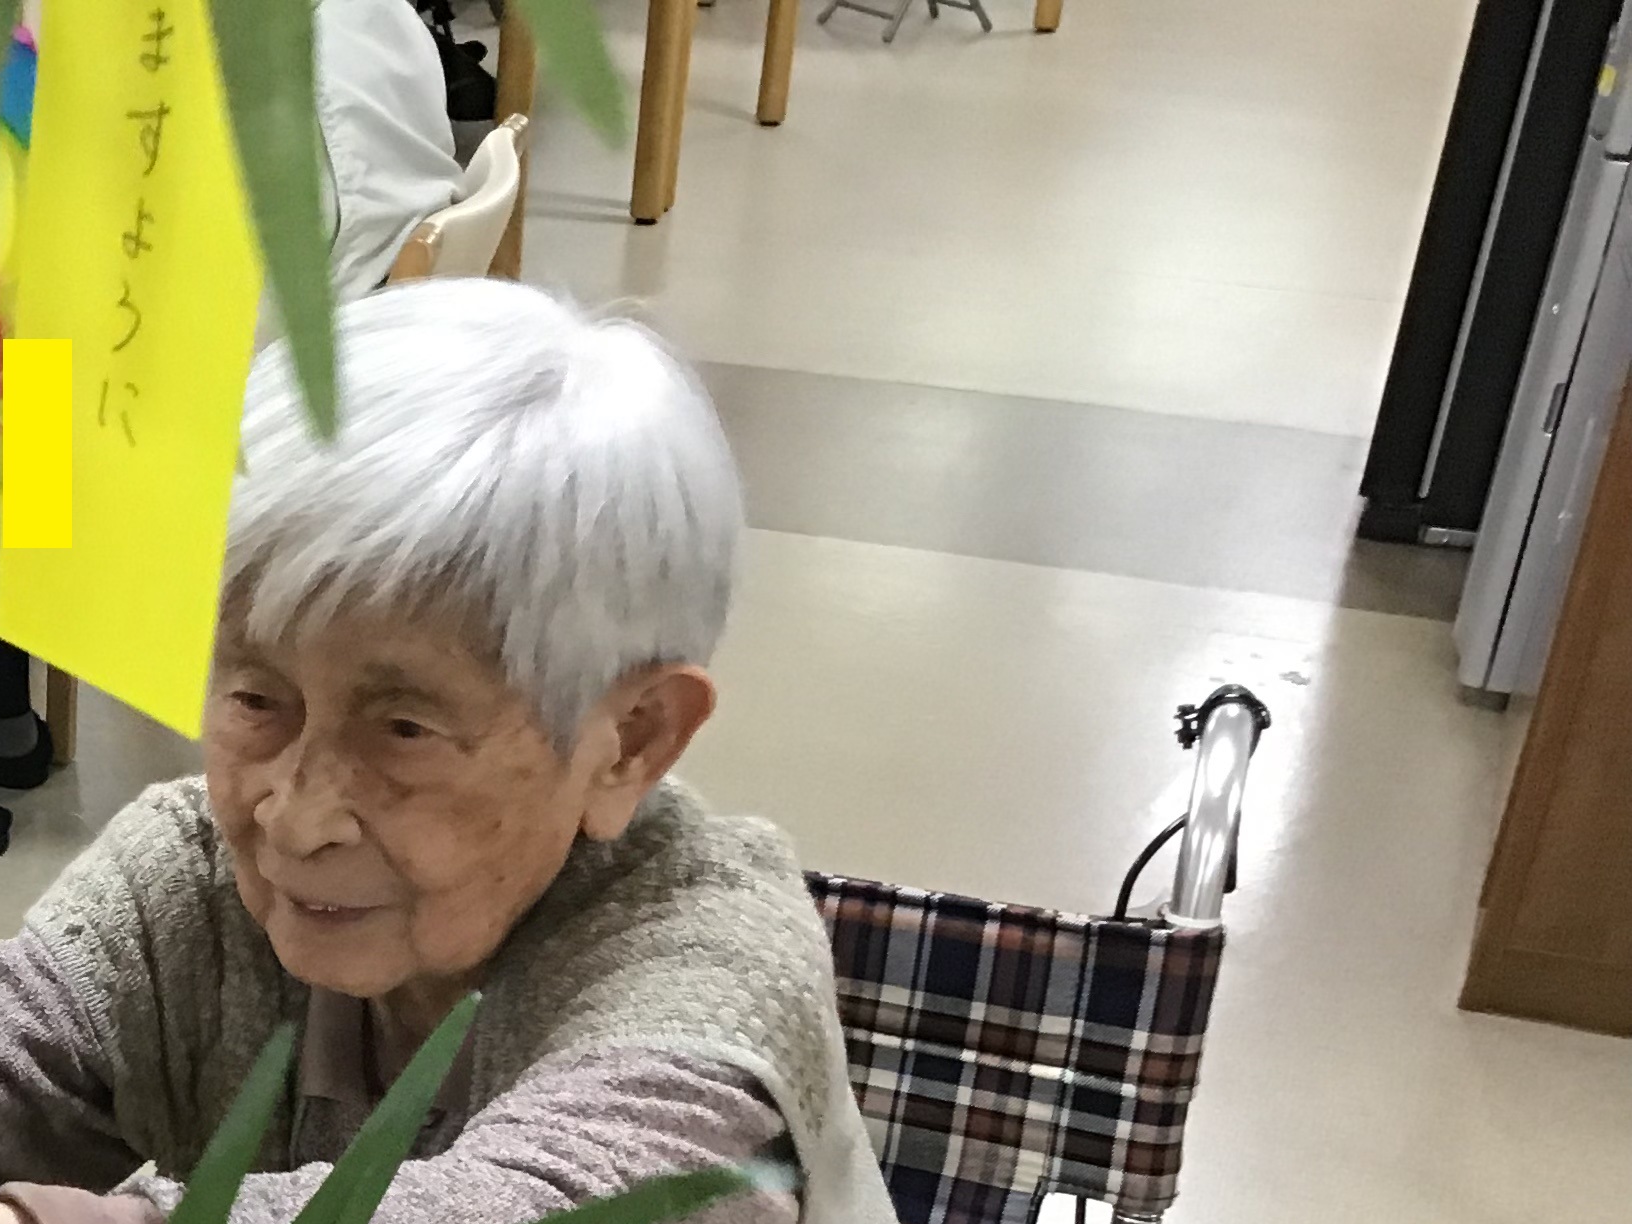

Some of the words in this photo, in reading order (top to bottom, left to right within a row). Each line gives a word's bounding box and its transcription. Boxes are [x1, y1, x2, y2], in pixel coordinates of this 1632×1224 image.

[98, 7, 173, 447] ますように
